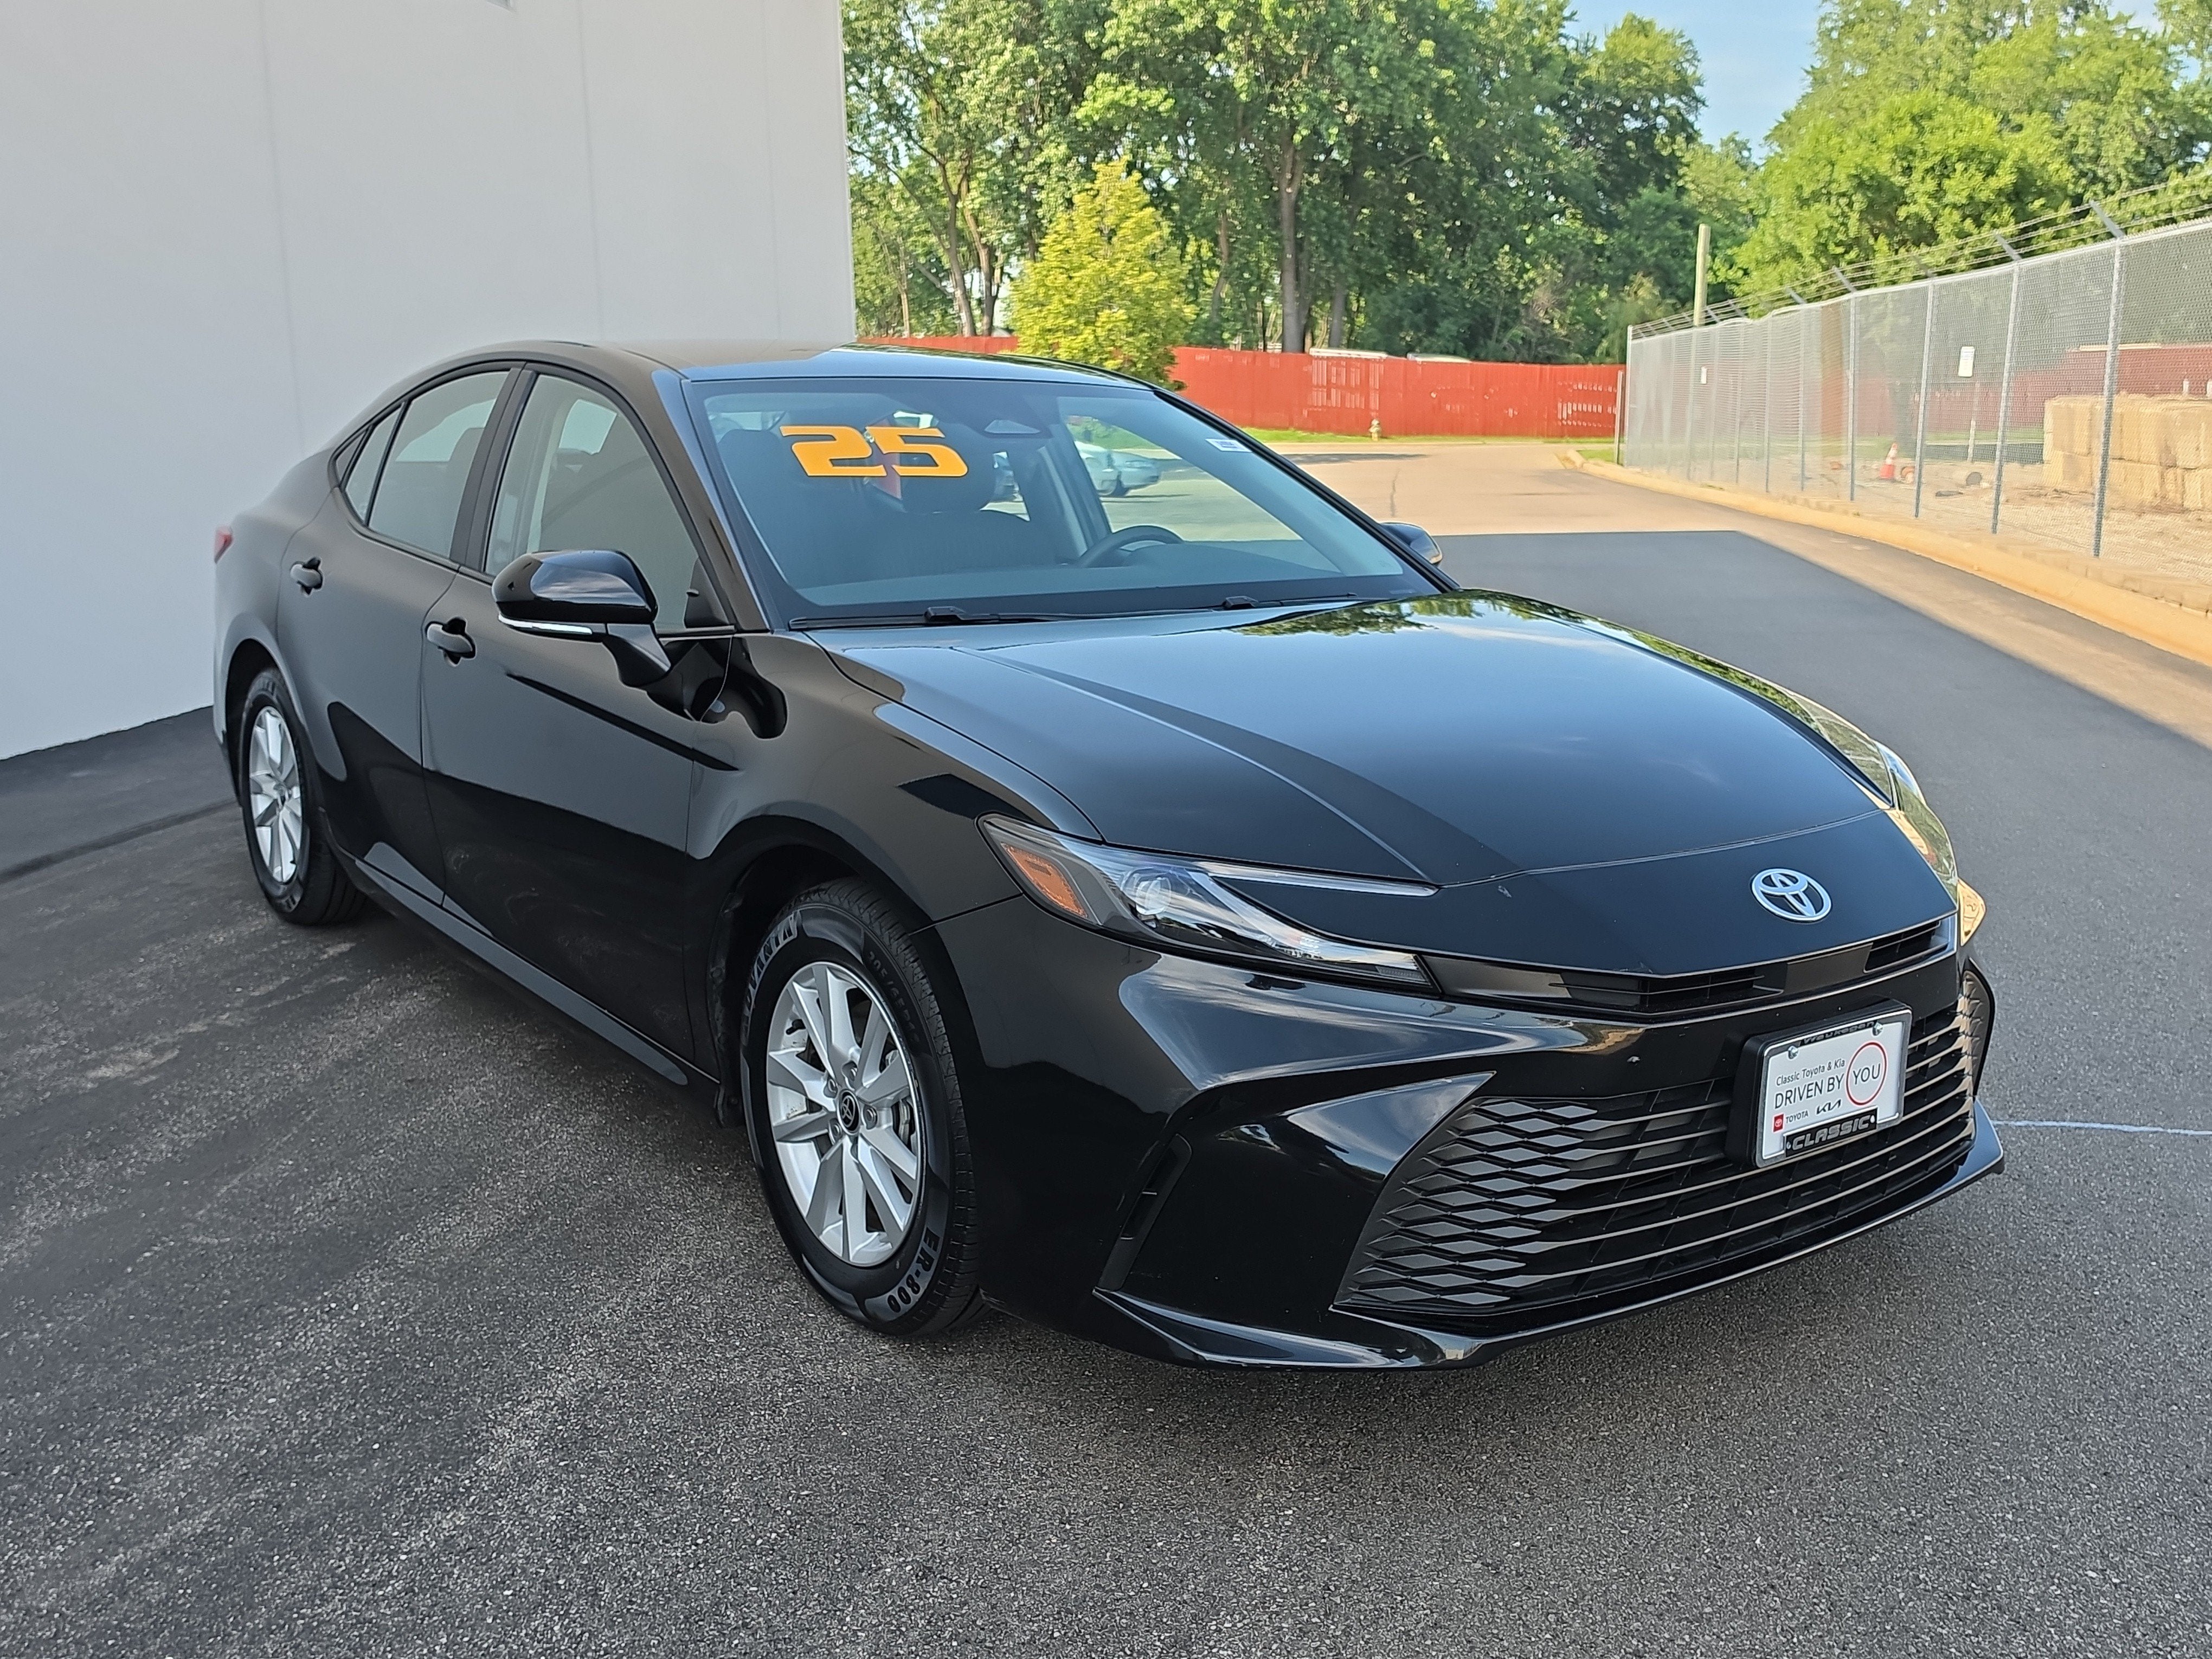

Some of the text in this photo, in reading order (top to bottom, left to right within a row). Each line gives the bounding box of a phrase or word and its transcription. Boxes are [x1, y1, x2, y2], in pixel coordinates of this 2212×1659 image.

[780, 425, 969, 477] 25
[1774, 1063, 1881, 1109] DRIVEN BY YOU
[1776, 1058, 1846, 1086] Classic Toyota & Kia
[1785, 1110, 1809, 1124] TOYOTA
[1792, 1115, 1871, 1150] CLASSIC
[886, 1226, 941, 1314] ER-800
